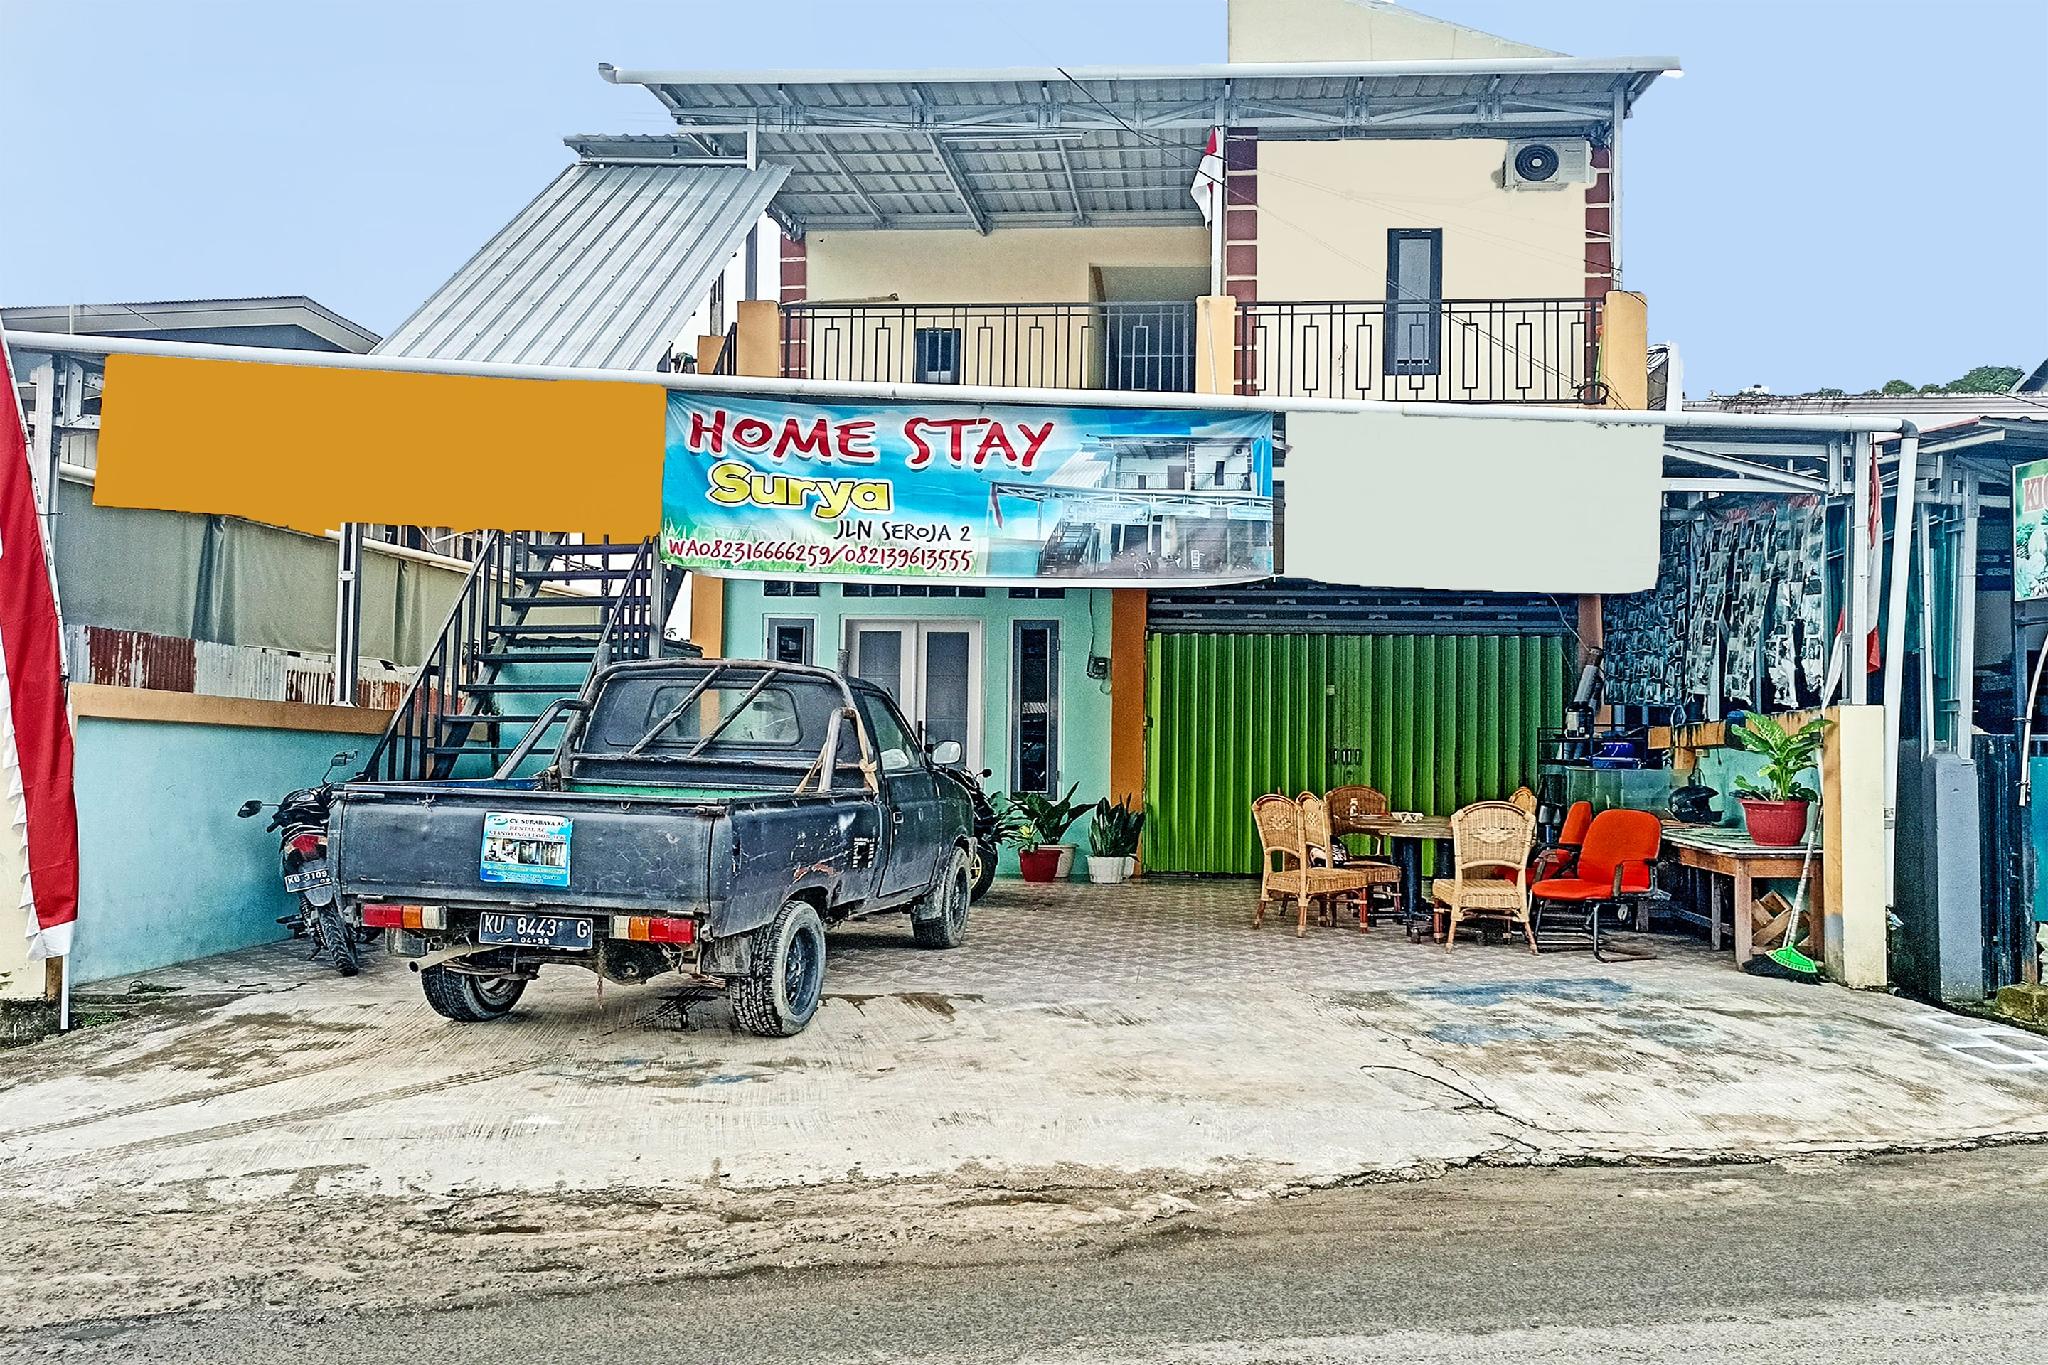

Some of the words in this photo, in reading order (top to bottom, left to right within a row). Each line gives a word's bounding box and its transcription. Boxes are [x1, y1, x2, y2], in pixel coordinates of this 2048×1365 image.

[689, 410, 876, 459] HOME
[904, 417, 1055, 470] STAY
[708, 462, 890, 518] Surya
[833, 520, 872, 540] JLN
[882, 522, 952, 542] SEROJA
[960, 525, 971, 542] 2
[484, 914, 505, 933] KU
[516, 916, 557, 936] 8443
